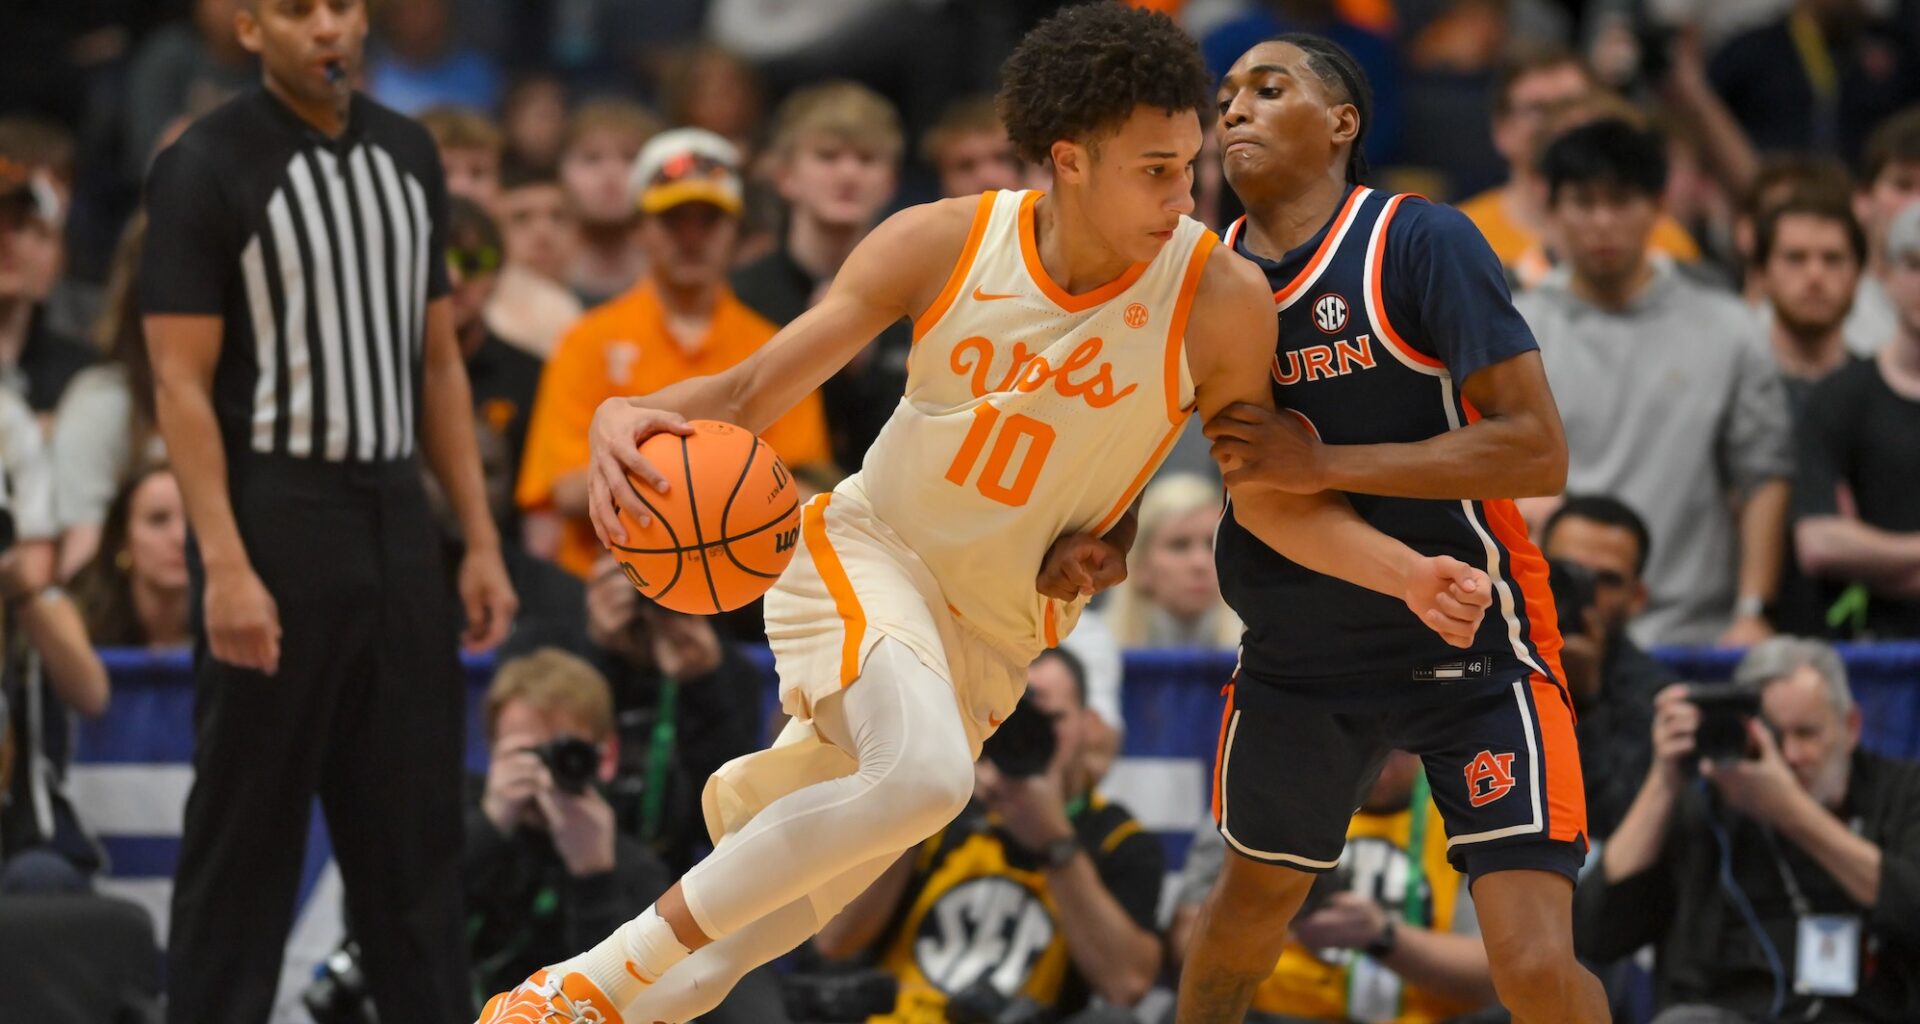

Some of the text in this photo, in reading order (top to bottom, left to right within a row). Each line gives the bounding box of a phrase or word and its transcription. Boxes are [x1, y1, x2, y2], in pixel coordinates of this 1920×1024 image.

[1125, 303, 1148, 328] SEC
[1315, 295, 1346, 331] SEC
[950, 336, 1138, 409] Vols
[1271, 334, 1377, 385] URN
[944, 400, 1057, 507] 10
[1468, 661, 1482, 673] 46
[915, 875, 1053, 998] SEC
